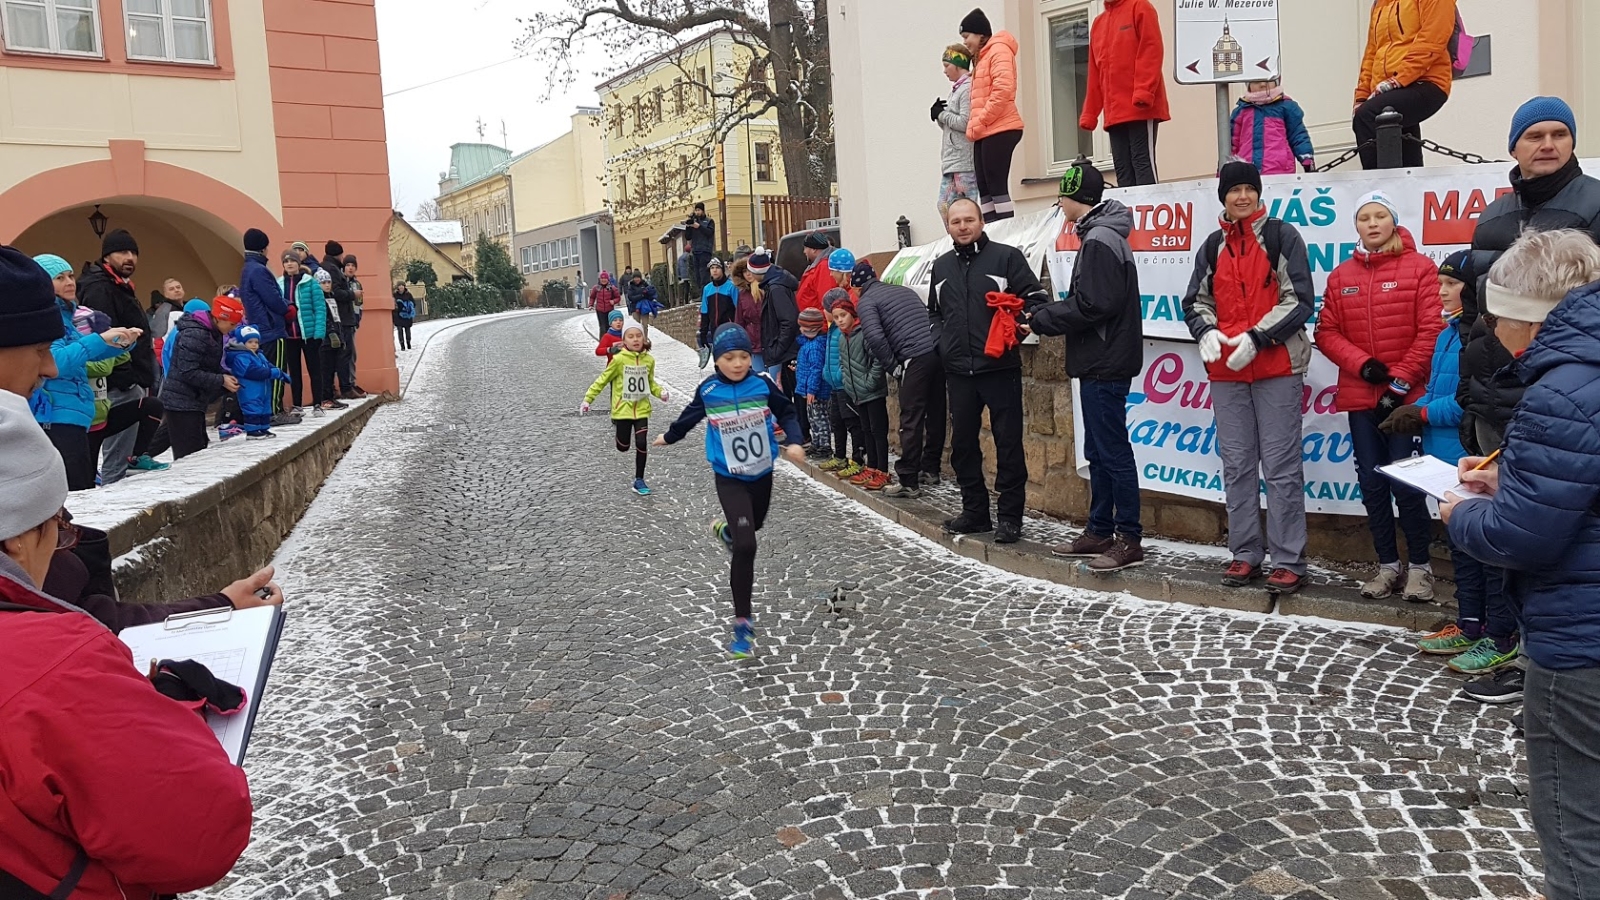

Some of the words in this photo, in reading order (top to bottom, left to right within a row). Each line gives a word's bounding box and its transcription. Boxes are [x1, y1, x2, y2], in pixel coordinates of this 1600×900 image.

[1179, 0, 1204, 8] Julie
[1208, 0, 1220, 8] W.
[1225, 0, 1274, 8] Mezerové
[1151, 234, 1187, 247] stav
[1137, 255, 1191, 265] lečnost
[628, 376, 646, 393] 80
[731, 431, 764, 463] 60
